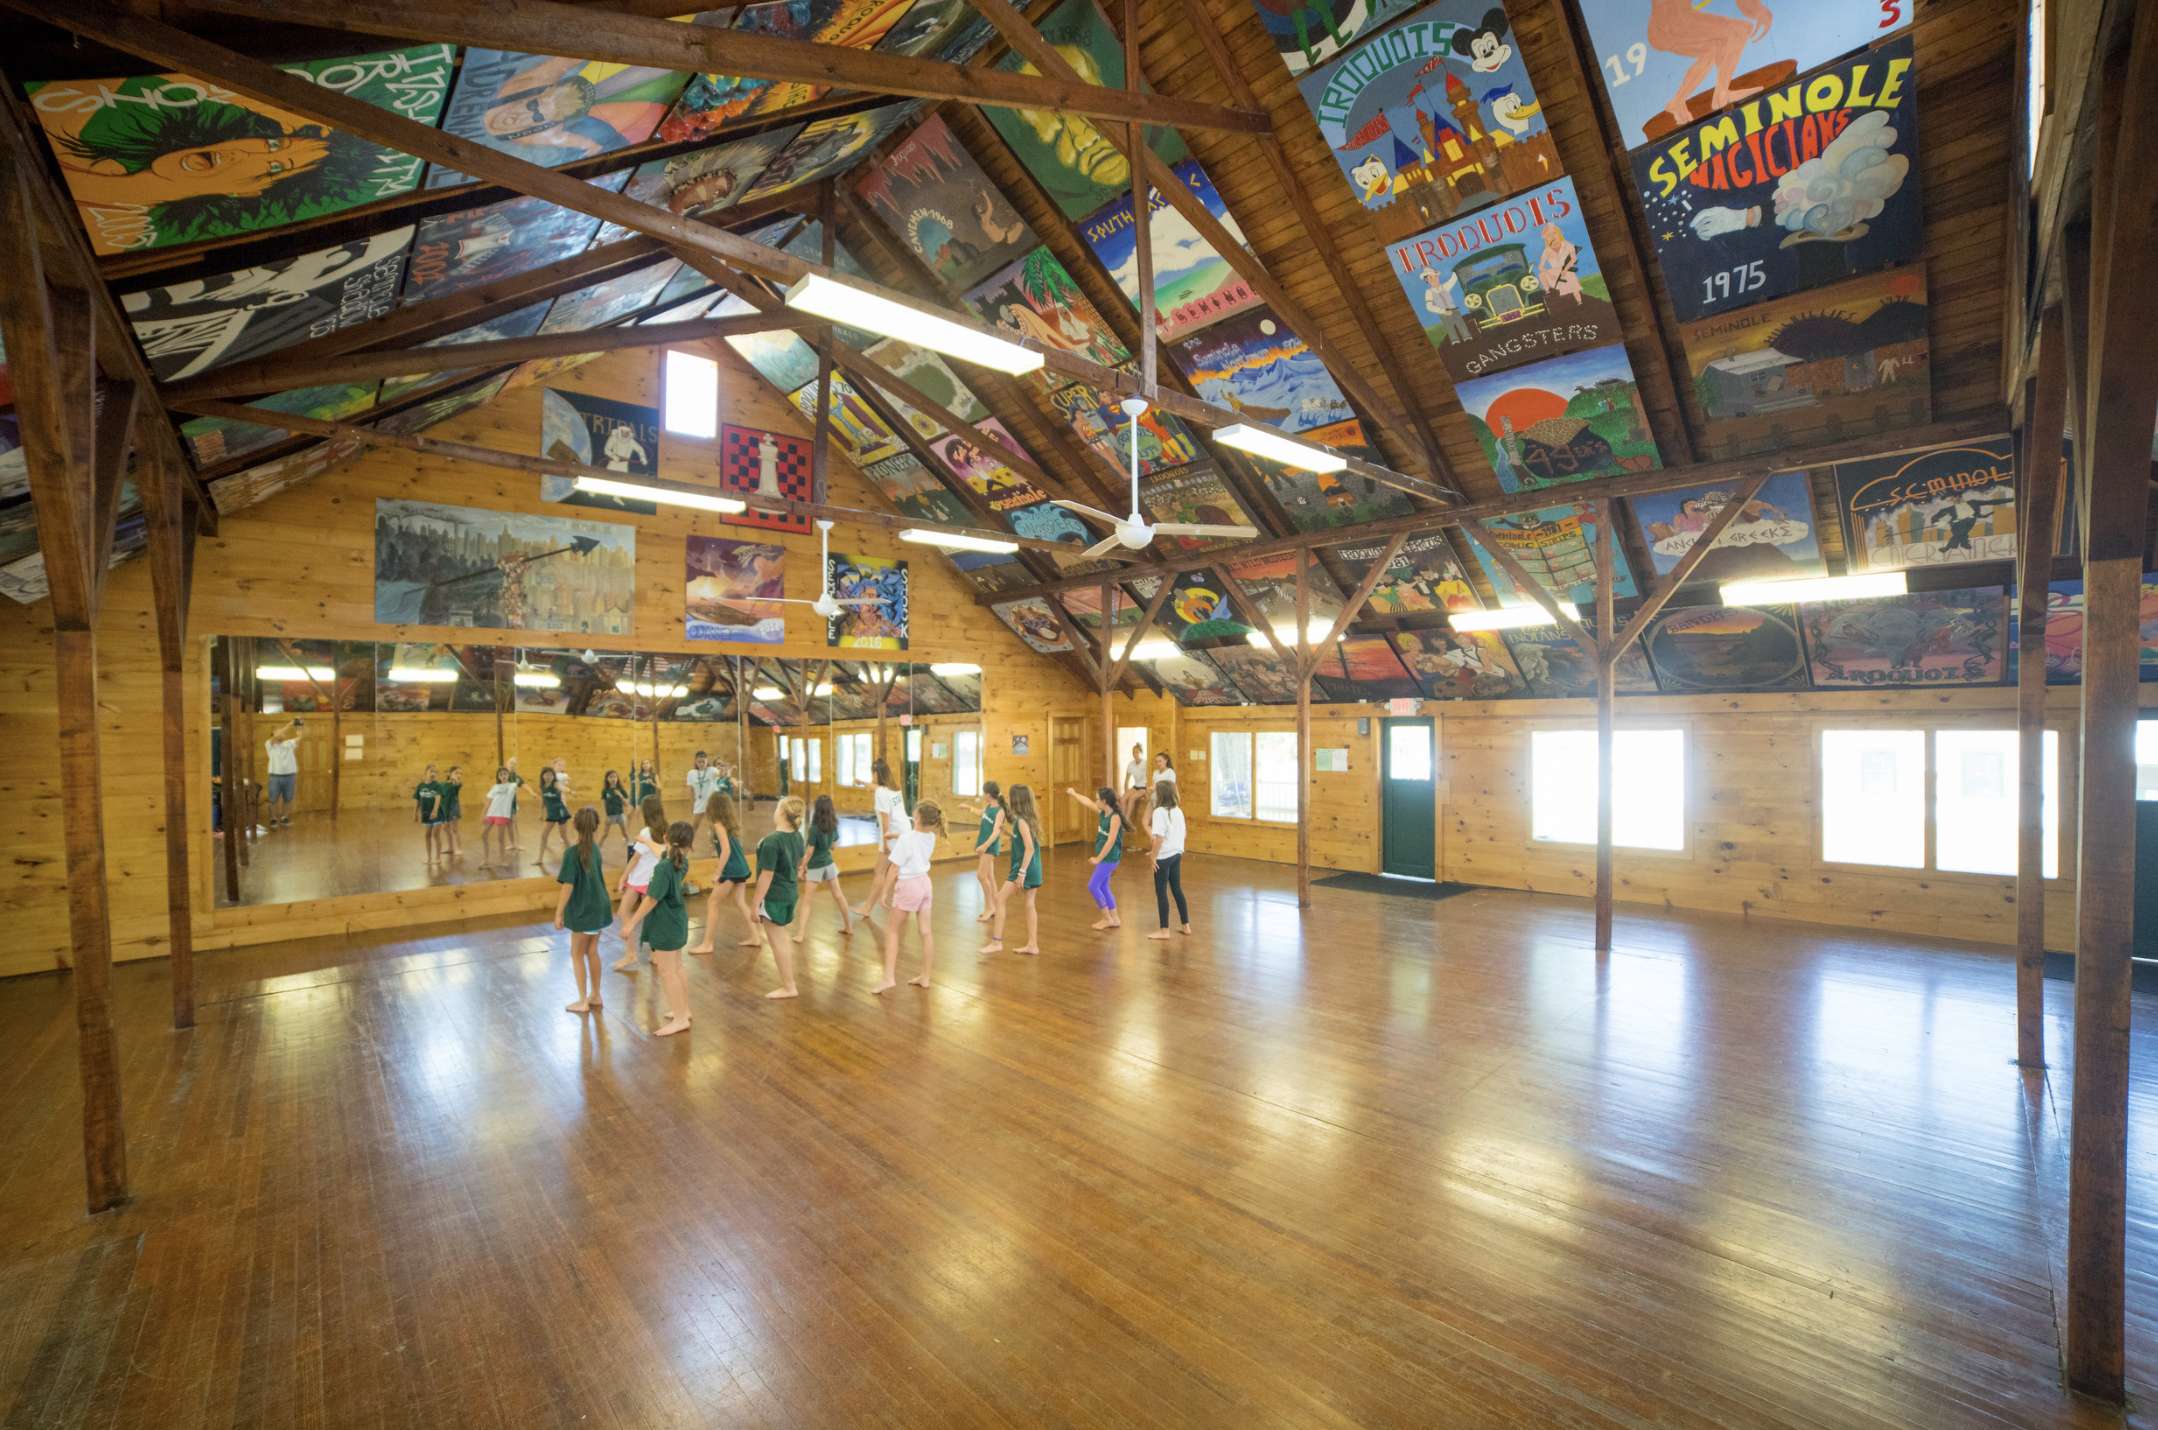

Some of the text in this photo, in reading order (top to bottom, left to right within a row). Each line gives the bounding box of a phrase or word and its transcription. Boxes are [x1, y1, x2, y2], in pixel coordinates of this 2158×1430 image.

[1316, 22, 1457, 128] IROQUOIS
[1649, 57, 1912, 199] SEMINOLE
[86, 201, 156, 249] 2005
[1086, 209, 1134, 243] SOUTH
[1396, 188, 1572, 274] IROQUOIS
[1702, 259, 1767, 304] 1975
[1465, 322, 1599, 374] GANGSTERS
[1693, 311, 1773, 343] SEMINOLE
